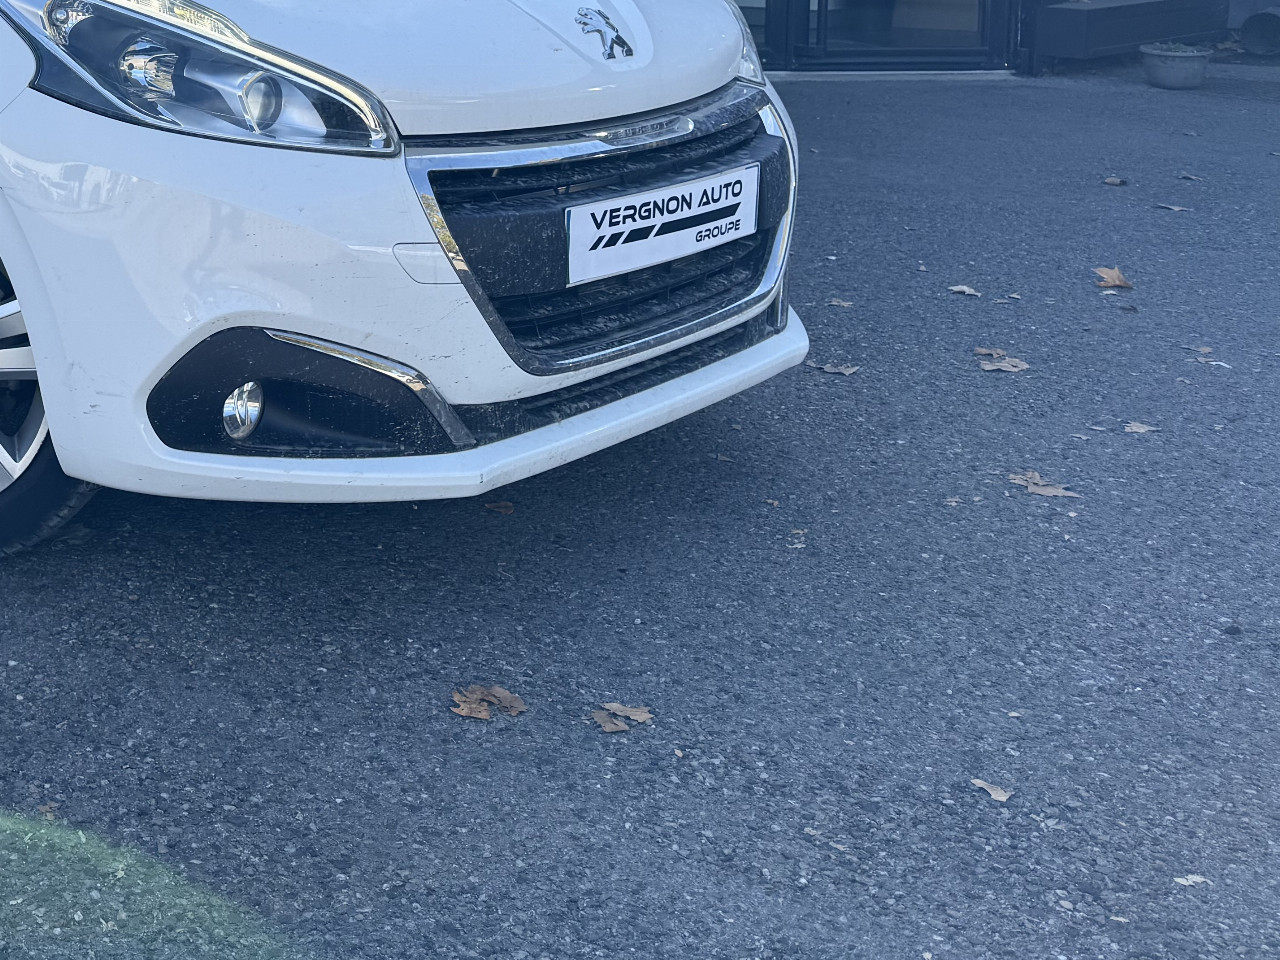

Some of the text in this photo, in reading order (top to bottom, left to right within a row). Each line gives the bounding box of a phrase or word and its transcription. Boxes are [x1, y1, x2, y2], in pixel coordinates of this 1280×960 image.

[590, 179, 743, 231] VERGNON AUTO
[695, 219, 742, 243] GROUPE
